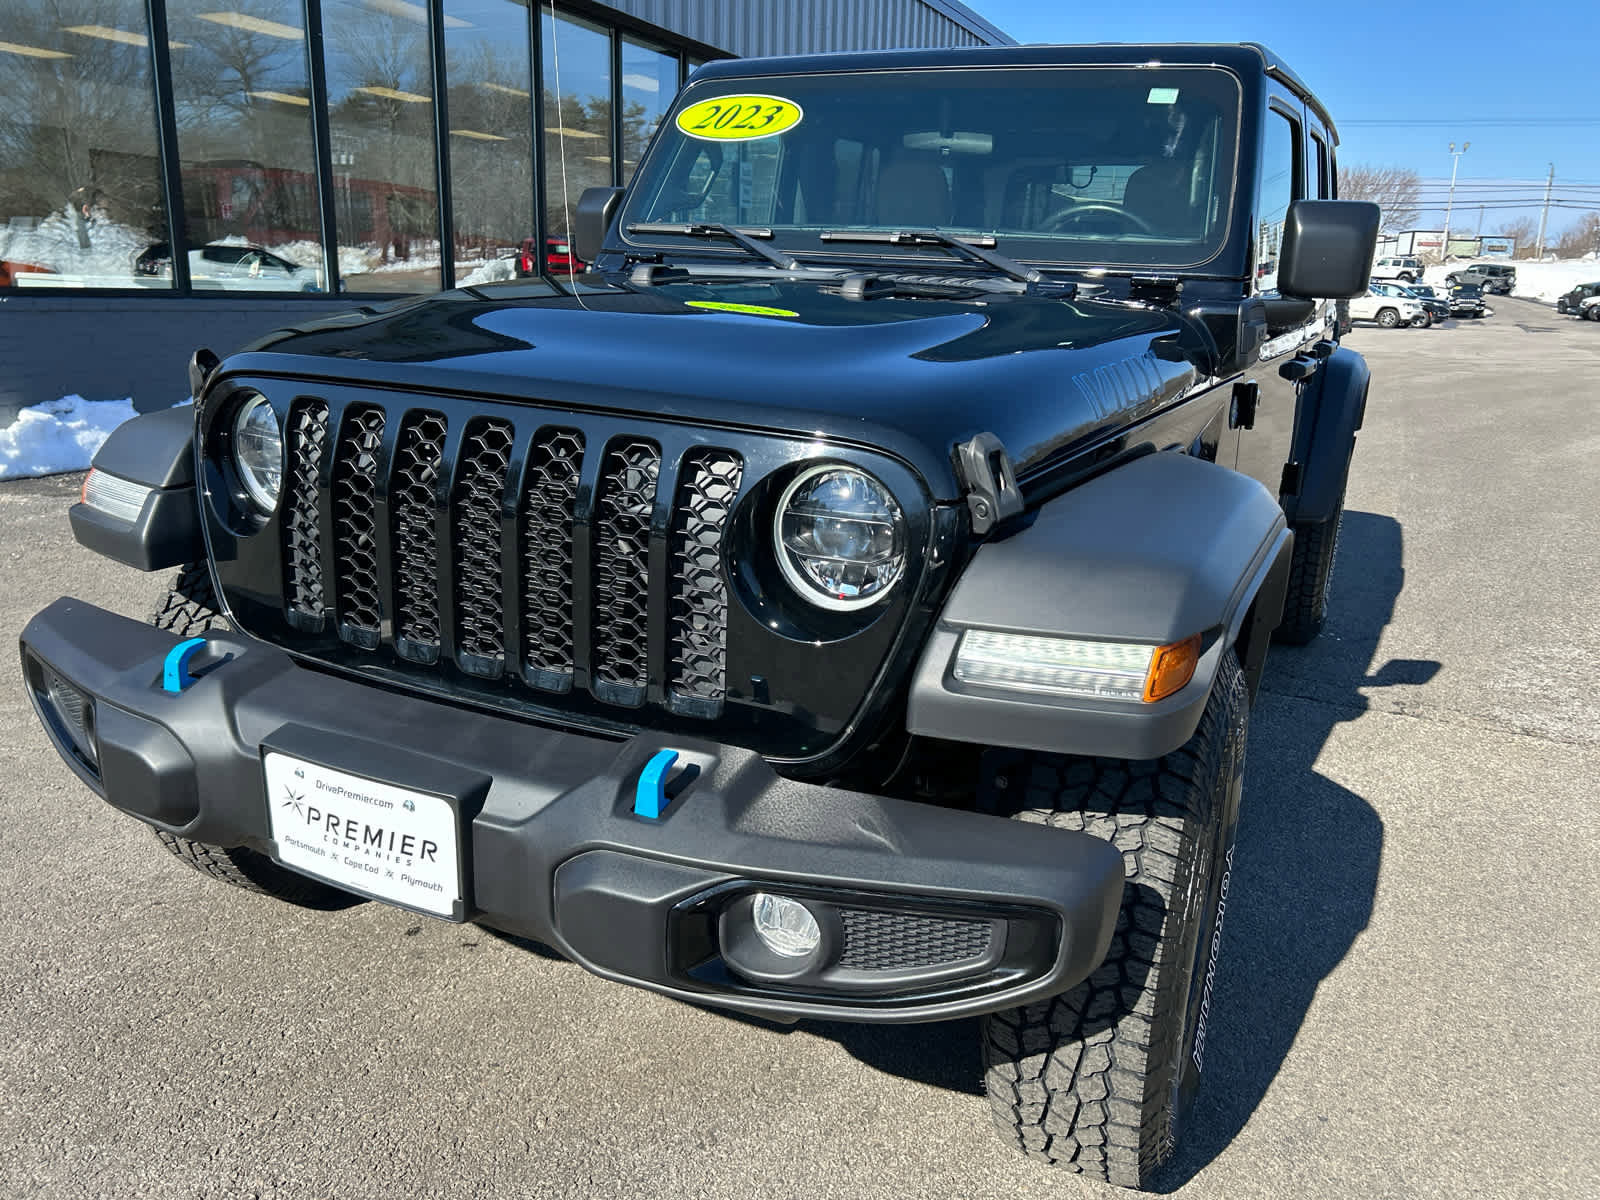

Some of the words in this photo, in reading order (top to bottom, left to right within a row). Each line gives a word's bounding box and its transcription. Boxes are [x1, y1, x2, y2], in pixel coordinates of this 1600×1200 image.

[690, 104, 784, 129] 2023
[315, 779, 394, 809] DrivePremier.com
[306, 806, 438, 862] PREMIER
[323, 834, 413, 866] COMPANIES
[284, 835, 326, 857] Portsmouth
[344, 856, 363, 870] Cape
[364, 863, 379, 874] Cod
[400, 873, 443, 893] Plymouth
[1192, 843, 1236, 1073] YOKOHAMA
